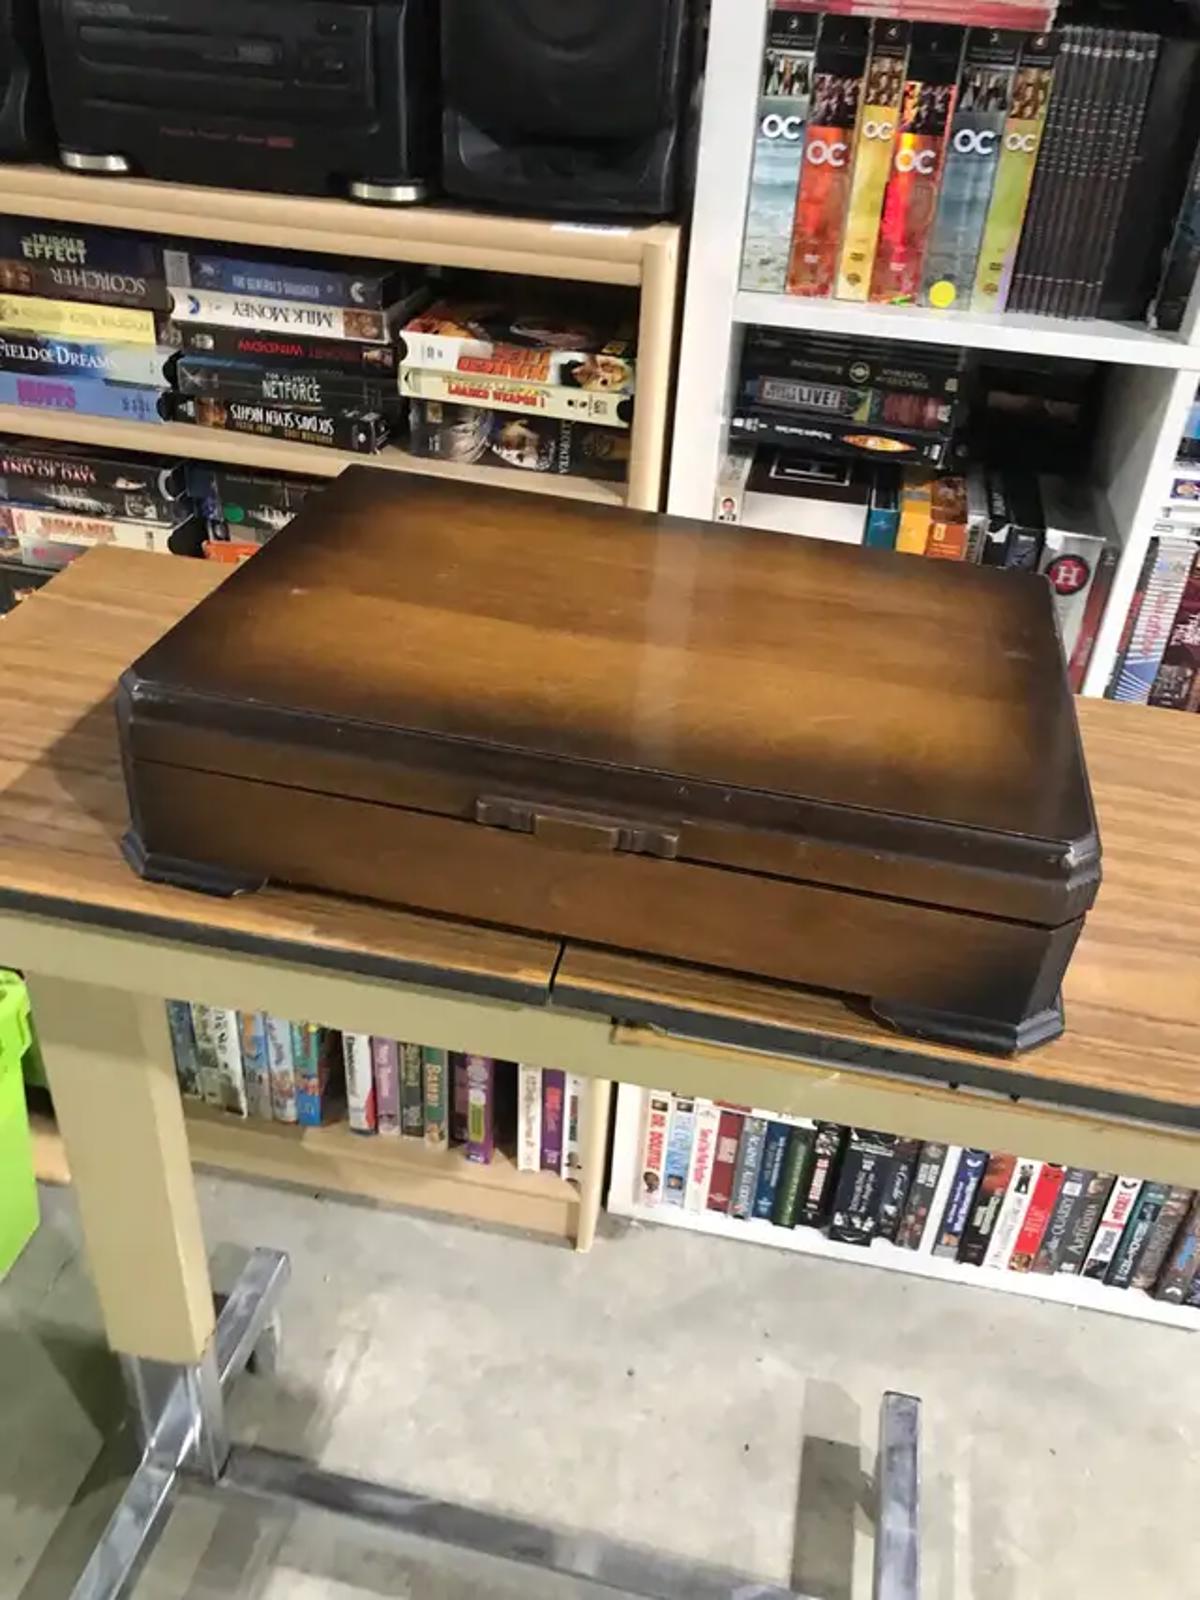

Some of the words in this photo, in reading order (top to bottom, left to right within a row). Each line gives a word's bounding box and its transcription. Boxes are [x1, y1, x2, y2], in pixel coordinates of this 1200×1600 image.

[762, 114, 803, 140] OC
[862, 120, 894, 141] OC
[954, 129, 997, 155] OC
[1005, 132, 1037, 153] OC
[806, 140, 848, 168] OC
[894, 148, 937, 174] OC
[21, 241, 87, 264] EFFECT
[50, 267, 147, 295] SCORCHER
[232, 301, 289, 324] MONEY
[294, 311, 335, 328] MILK
[261, 380, 322, 402] NETFORCE
[230, 404, 263, 424] NIGHTS
[264, 407, 294, 429] SEVEN
[1, 461, 34, 477] END
[38, 464, 57, 478] OF
[61, 465, 97, 483] DAYS
